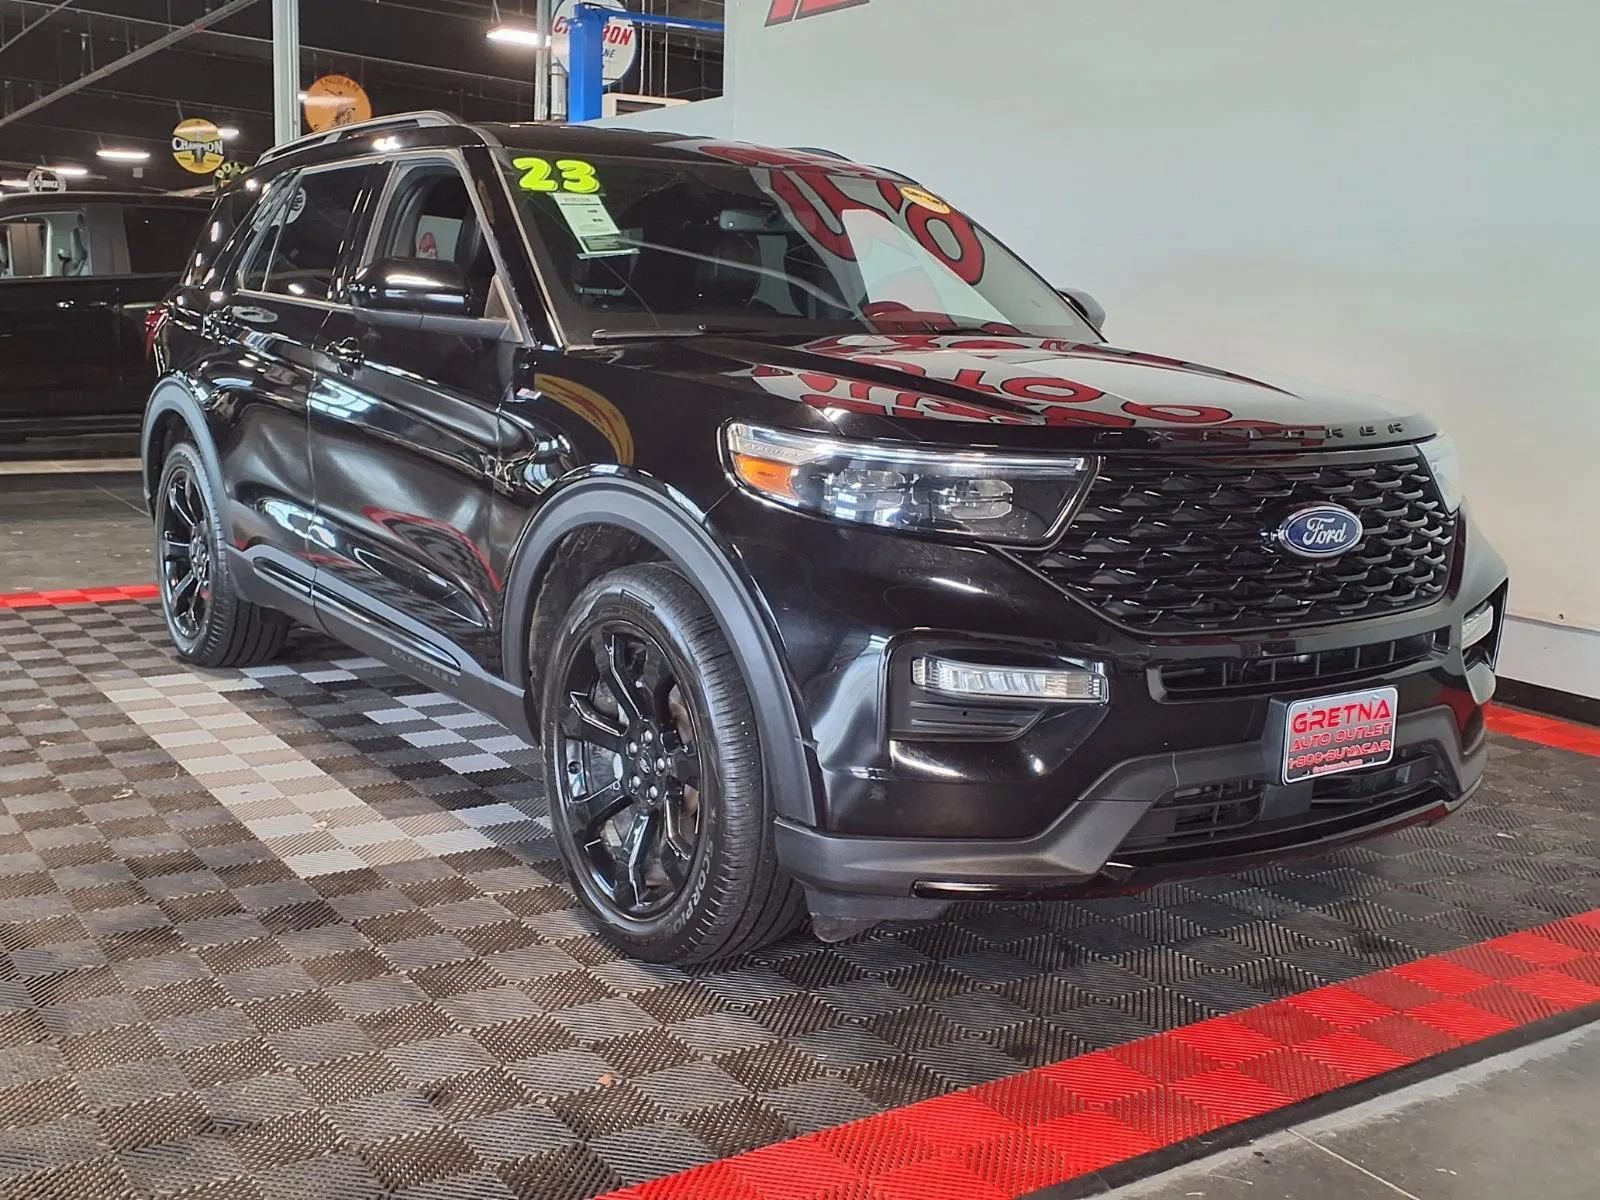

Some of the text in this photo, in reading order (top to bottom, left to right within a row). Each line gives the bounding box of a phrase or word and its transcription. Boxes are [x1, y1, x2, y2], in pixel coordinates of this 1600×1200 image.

[553, 15, 633, 46] CRON
[512, 156, 601, 193] 23
[1302, 517, 1347, 546] Ford
[1292, 699, 1392, 734] GRETNA
[1289, 722, 1393, 753] AUTO OUTLET
[664, 837, 714, 938] SCORPIO
